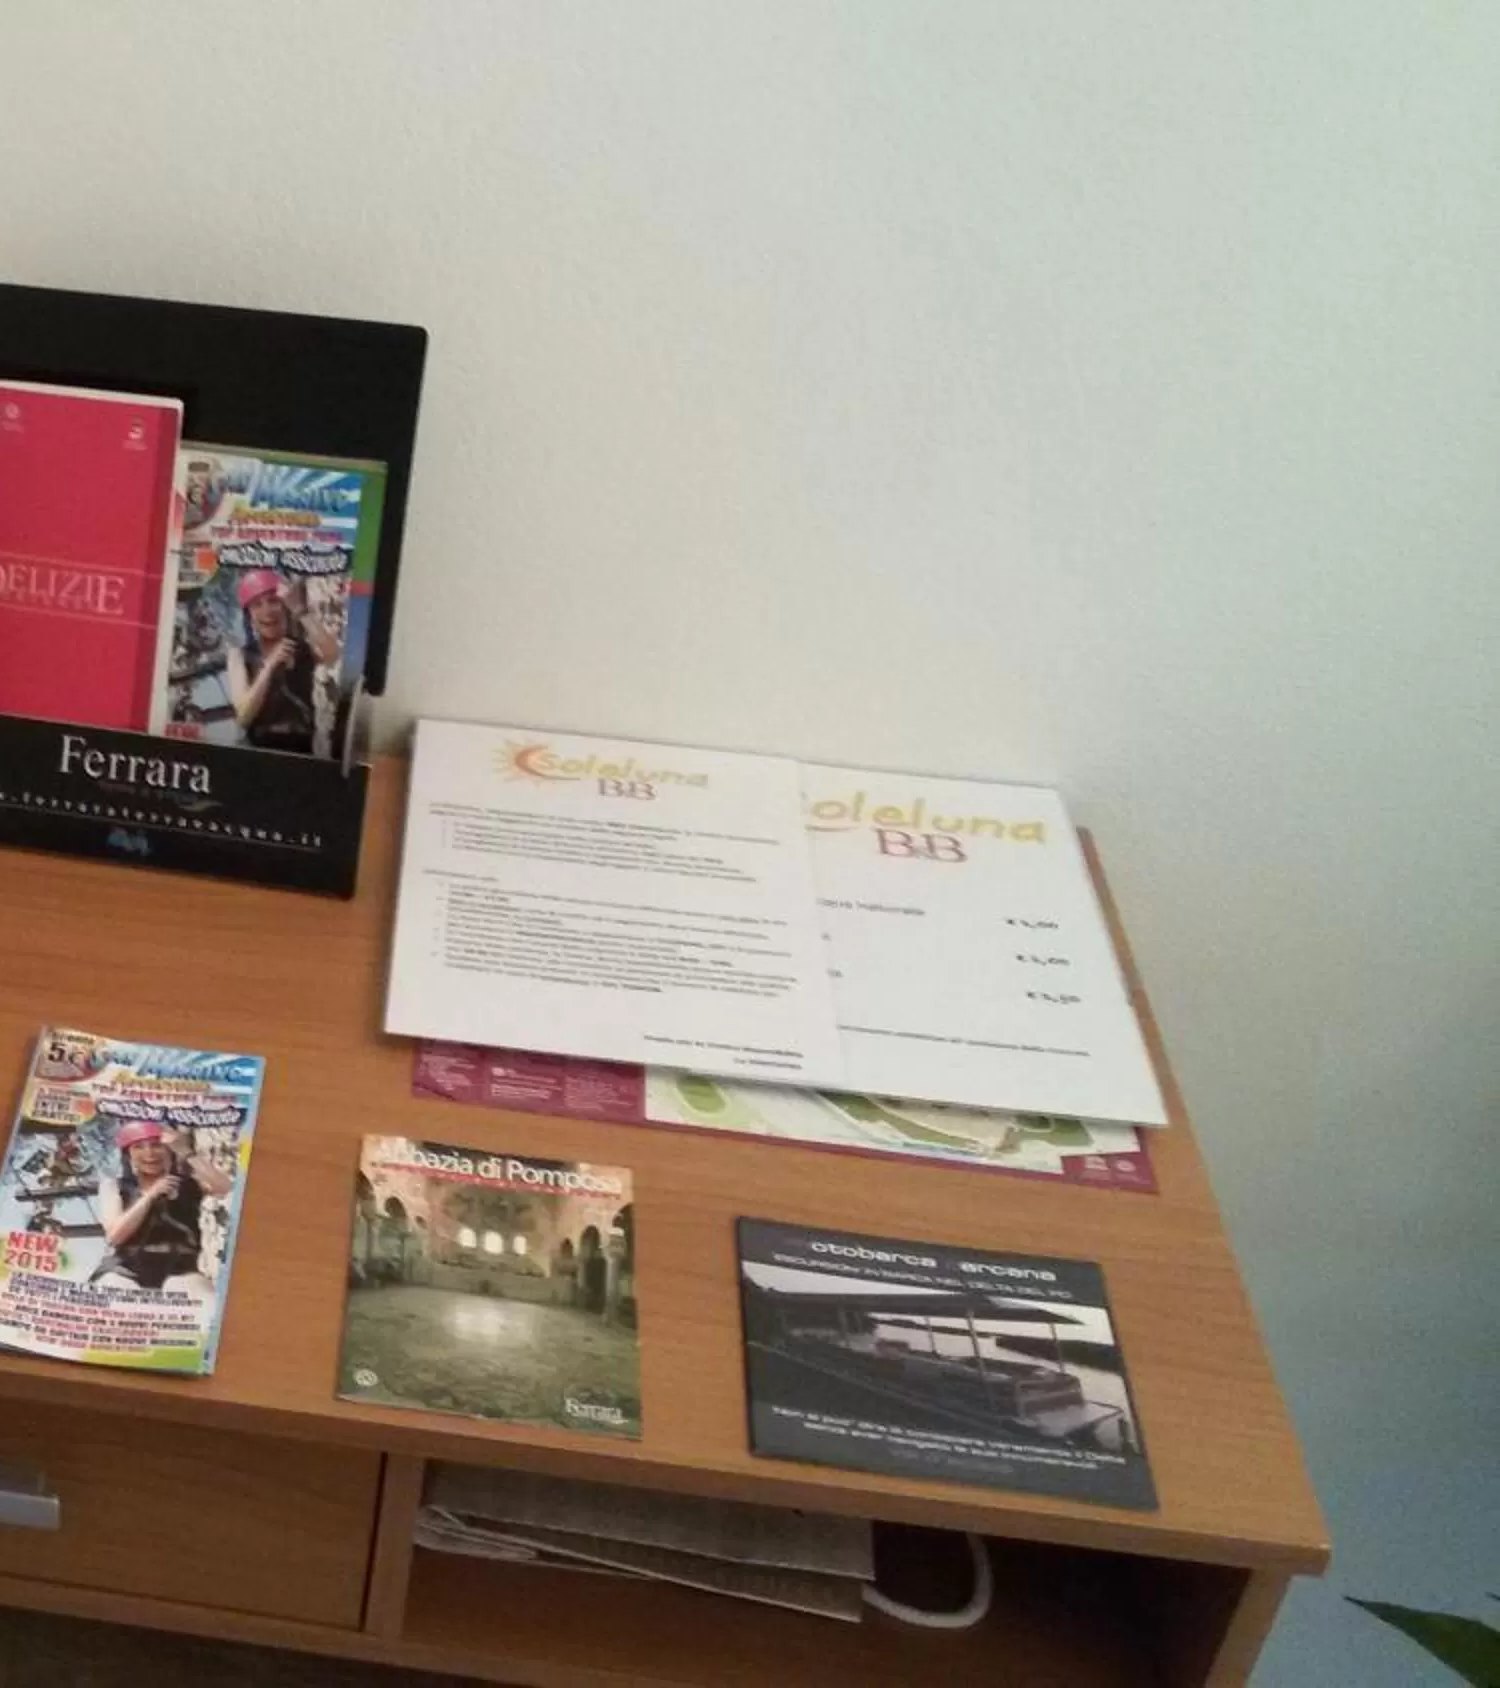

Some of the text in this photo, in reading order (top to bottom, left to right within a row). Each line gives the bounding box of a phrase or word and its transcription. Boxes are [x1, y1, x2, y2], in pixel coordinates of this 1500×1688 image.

[59, 734, 211, 794] Ferrara
[808, 790, 1048, 843] oleluna
[477, 1156, 503, 1179] di
[6, 1231, 59, 1252] NEW
[4, 1250, 58, 1273] 2015
